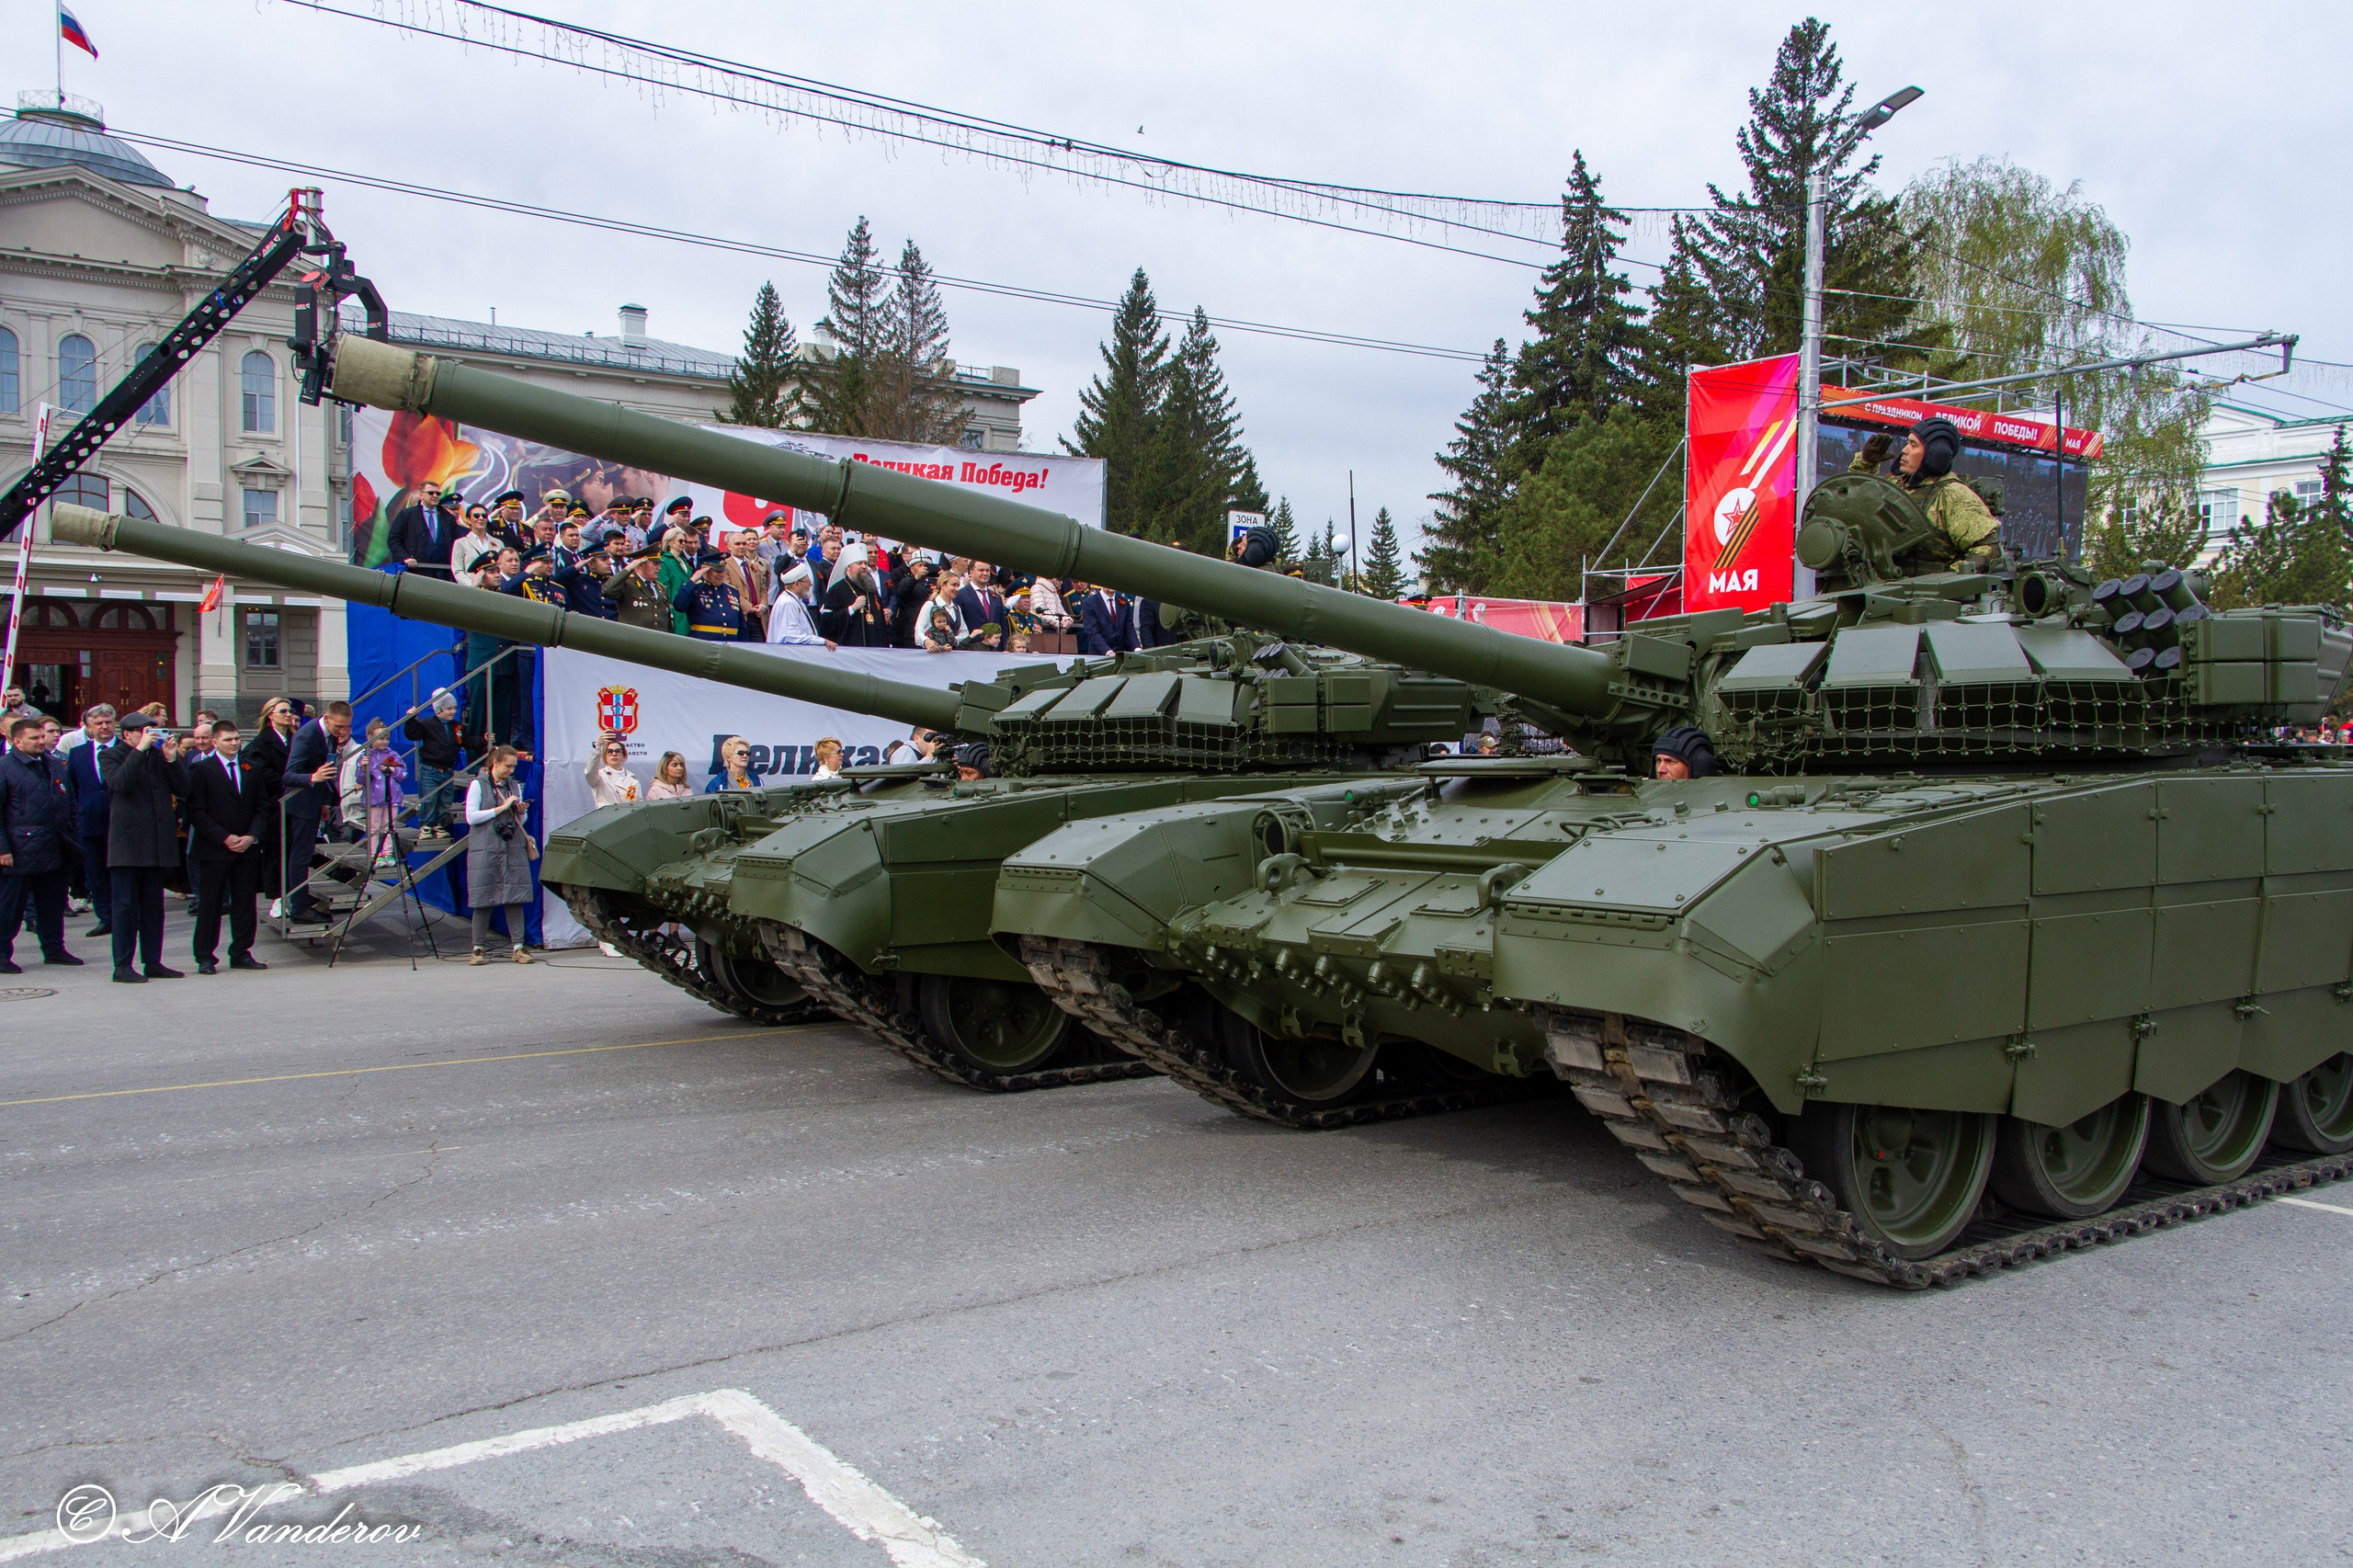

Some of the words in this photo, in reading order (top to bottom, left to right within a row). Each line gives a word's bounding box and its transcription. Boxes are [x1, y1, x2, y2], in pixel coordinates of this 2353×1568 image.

[1865, 403, 1871, 412] С
[1872, 404, 1923, 421] ПРАЗДНИКОМ
[1994, 421, 2039, 441] ПОБЕДЫ!
[2065, 437, 2082, 449] МАЯ
[960, 461, 1050, 494] Победа!
[1235, 515, 1258, 525] ЗОНА
[1709, 568, 1758, 594] МАЯ
[708, 733, 891, 775] елиа
